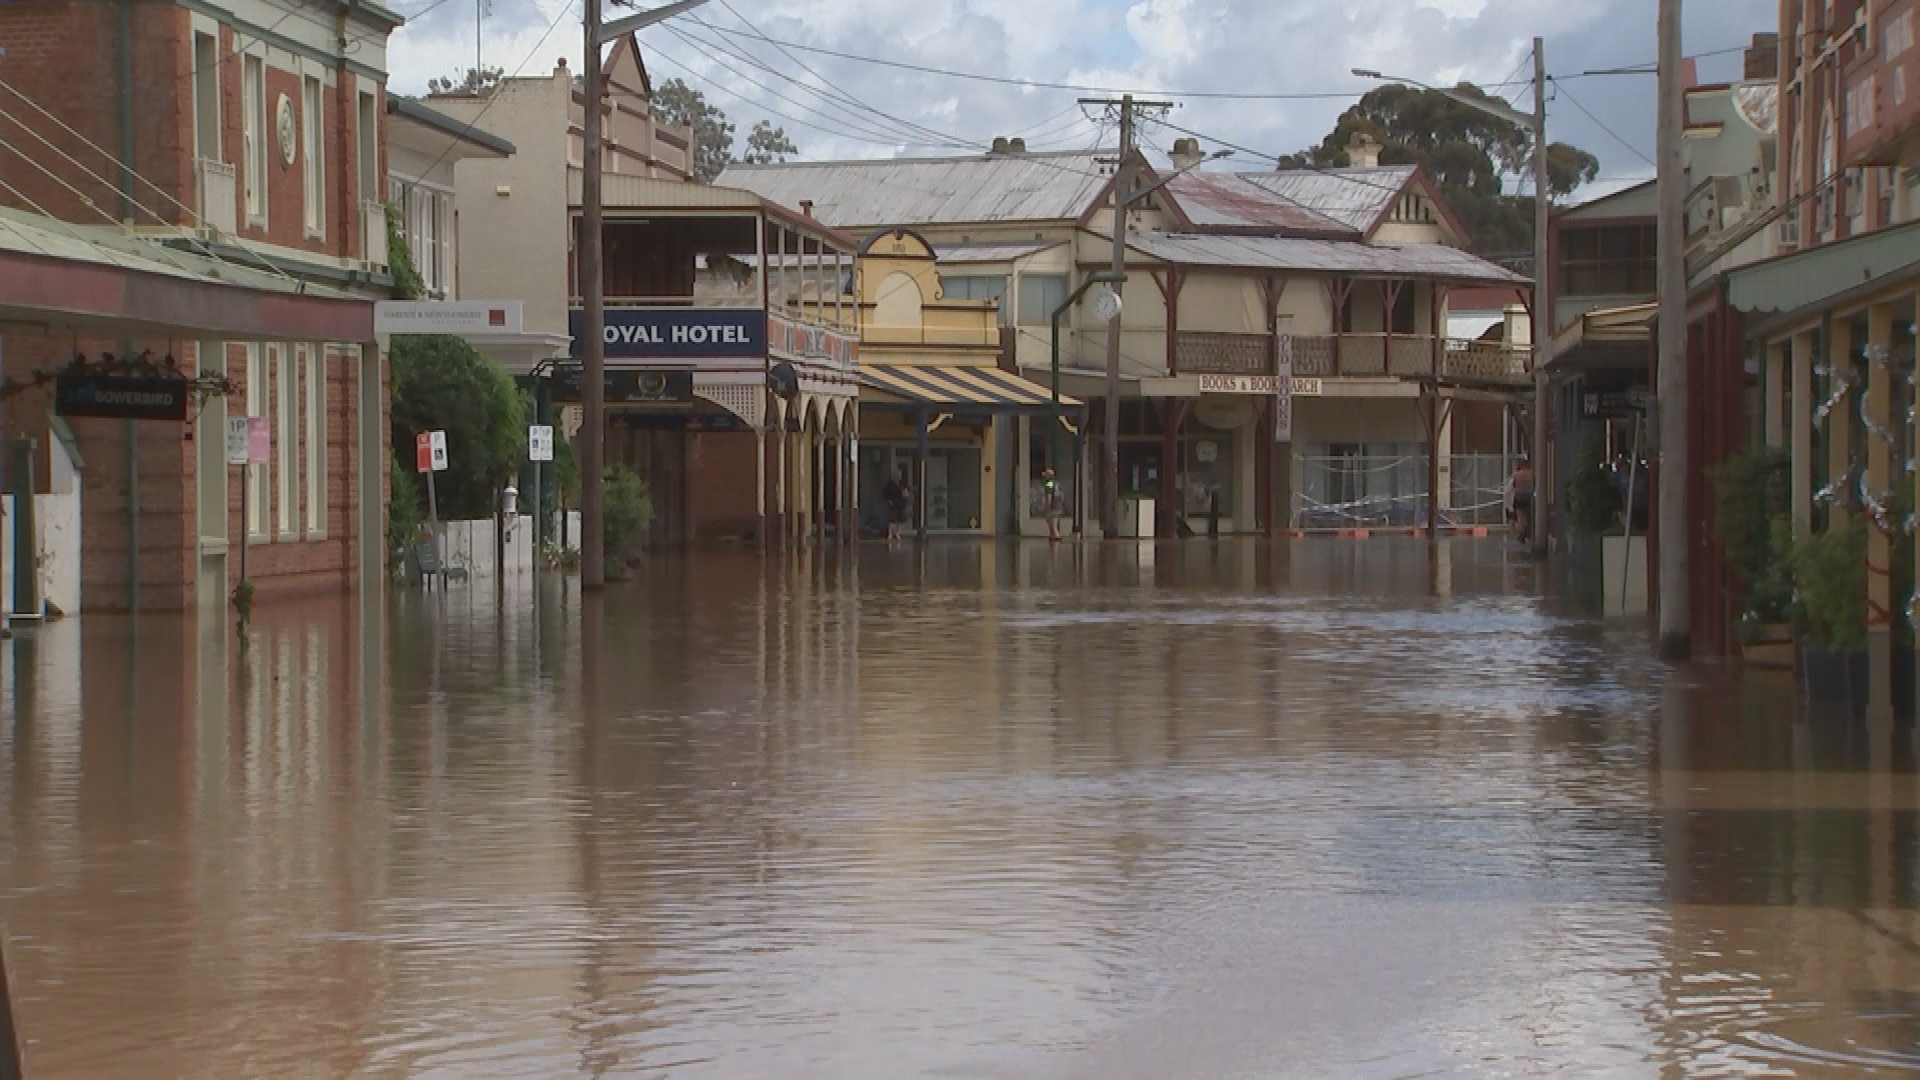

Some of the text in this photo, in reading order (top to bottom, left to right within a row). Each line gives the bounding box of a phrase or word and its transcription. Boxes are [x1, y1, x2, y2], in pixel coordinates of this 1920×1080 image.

[604, 325, 750, 343] OYAL HOTEL
[1280, 333, 1290, 364] OLD
[1202, 375, 1236, 390] BOOKS
[95, 390, 173, 406] BOWERBIRD
[230, 420, 245, 432] 1P
